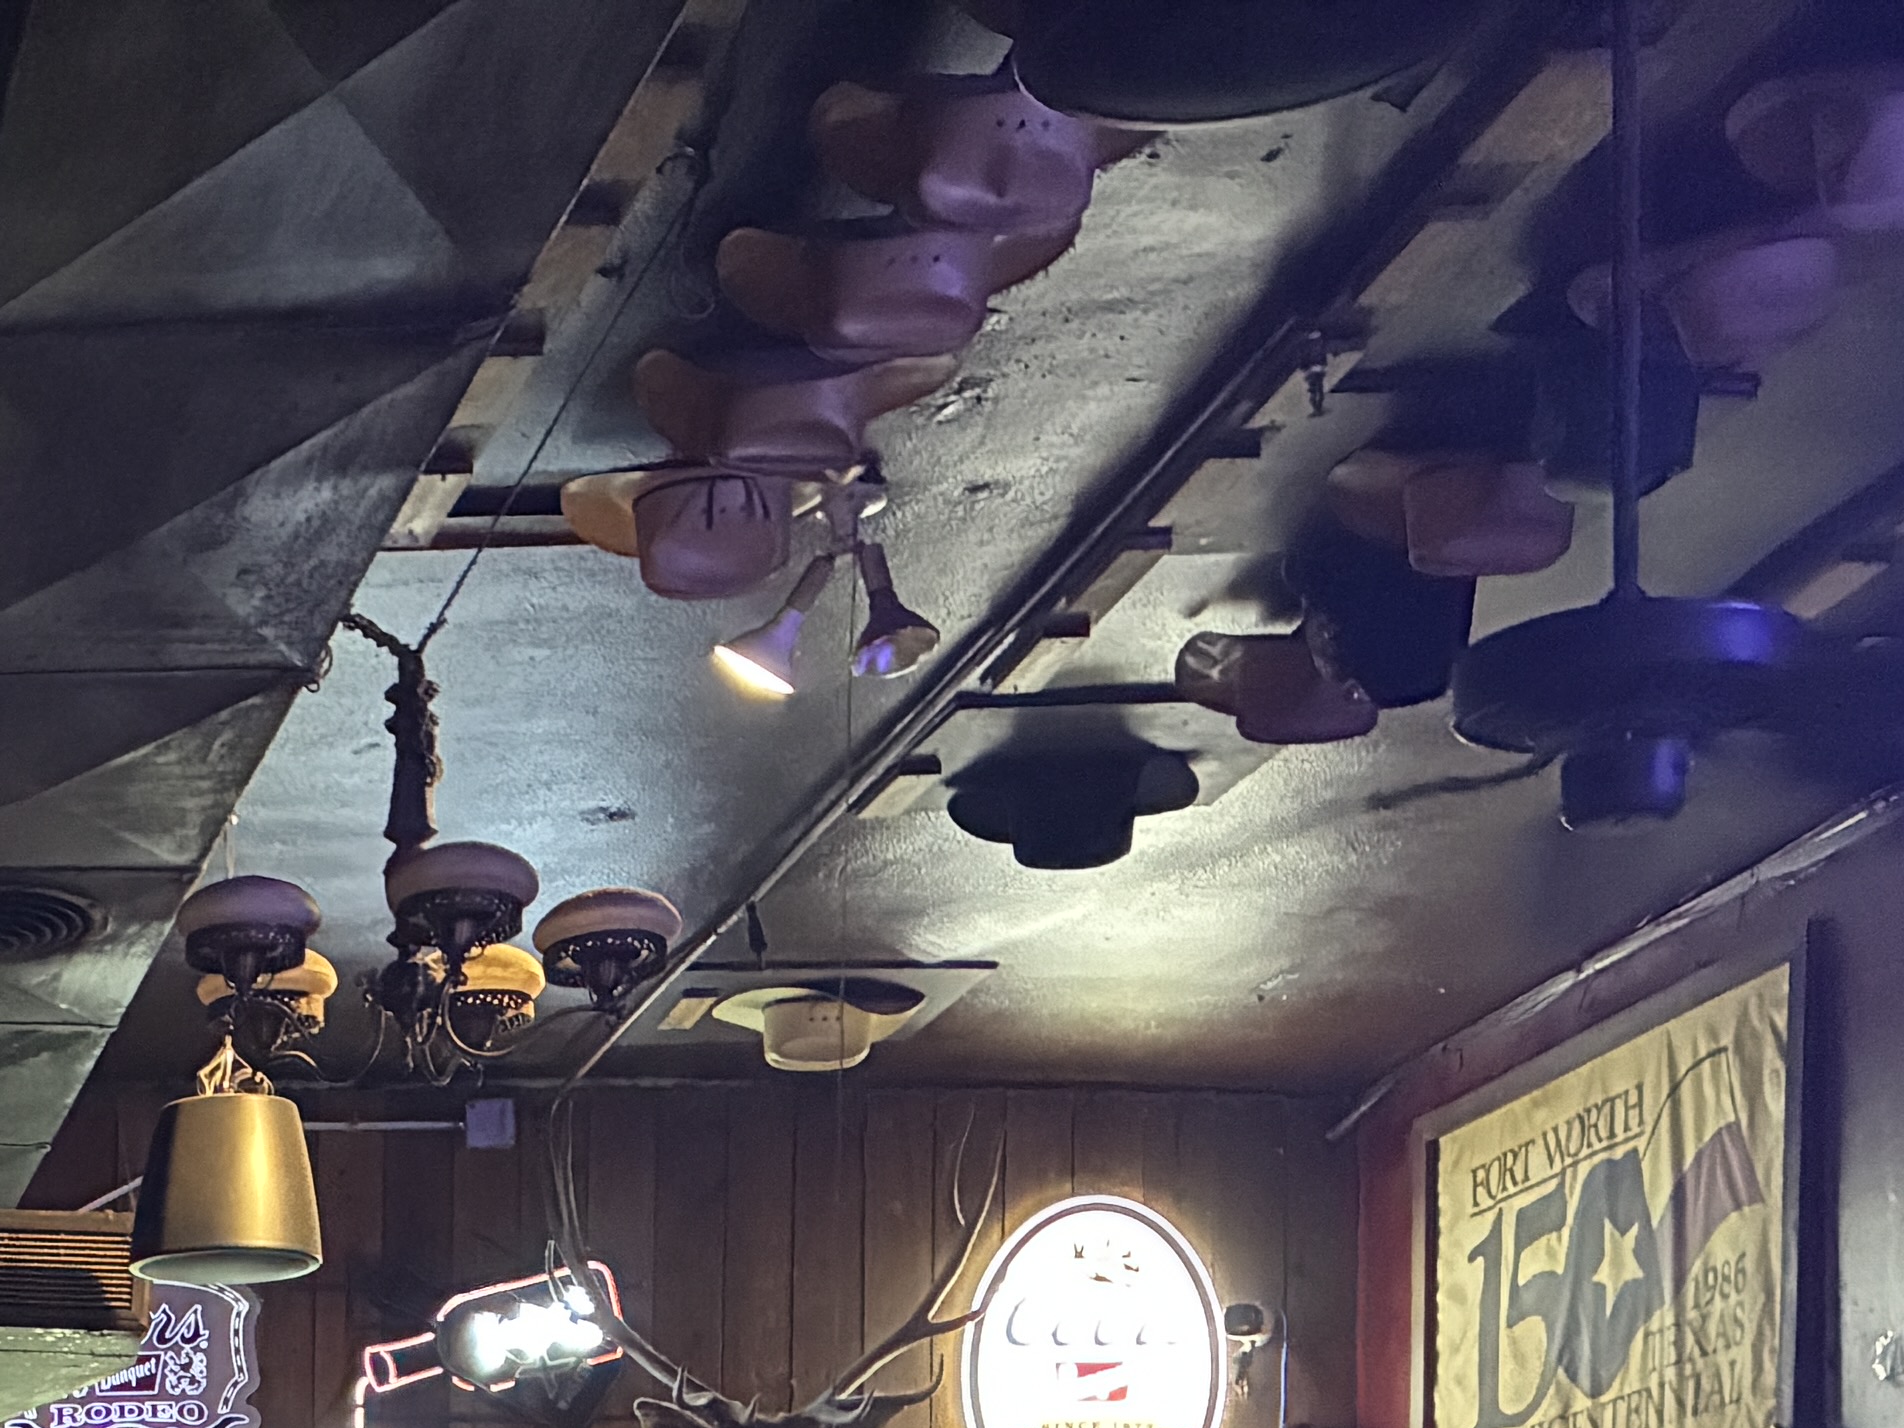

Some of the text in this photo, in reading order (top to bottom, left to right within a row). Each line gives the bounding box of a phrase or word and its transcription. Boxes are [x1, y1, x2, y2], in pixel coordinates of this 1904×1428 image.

[1471, 1081, 1645, 1208] FORT WORTH
[1691, 1252, 1748, 1316] 1986
[1646, 1303, 1747, 1374] TEXAS
